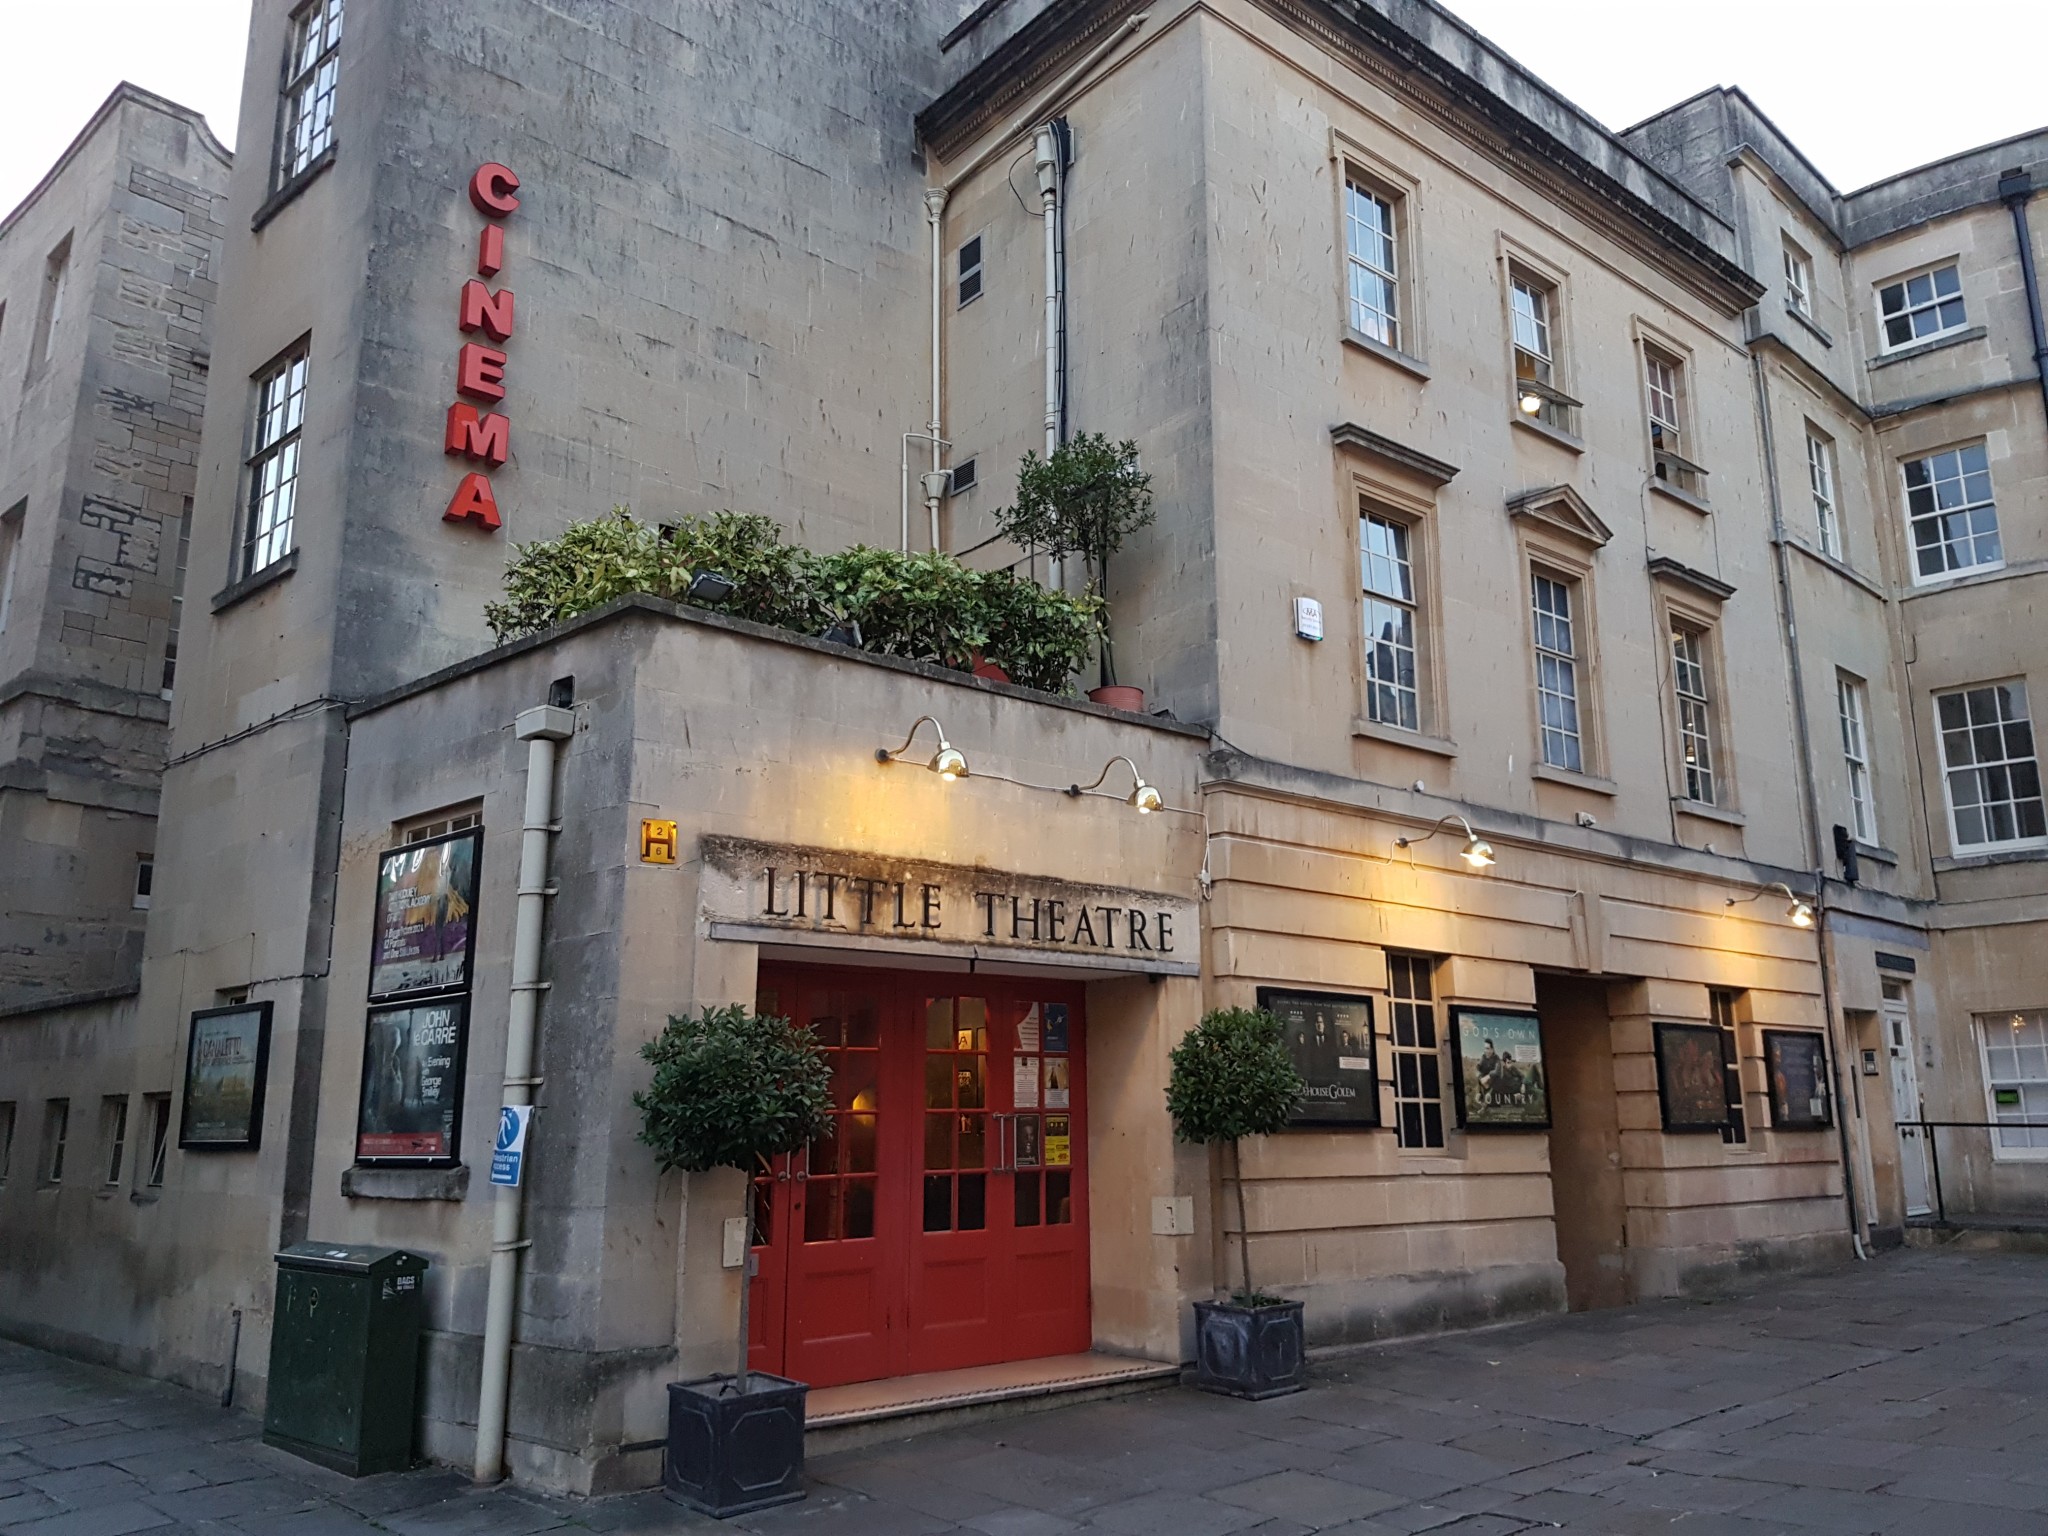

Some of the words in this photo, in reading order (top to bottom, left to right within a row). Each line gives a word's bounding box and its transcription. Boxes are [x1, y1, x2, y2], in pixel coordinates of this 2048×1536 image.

[442, 162, 521, 531] CINEMA
[656, 827, 663, 836] 2
[645, 822, 673, 860] H
[655, 847, 662, 856] 6
[764, 866, 942, 929] LITTLE
[975, 891, 1174, 953] THEATRE
[422, 1009, 451, 1029] JOHN
[1463, 1026, 1500, 1039] GOD'S
[1508, 1028, 1536, 1040] OWN
[422, 1076, 442, 1089] George
[1475, 1093, 1535, 1105] COUNTRY
